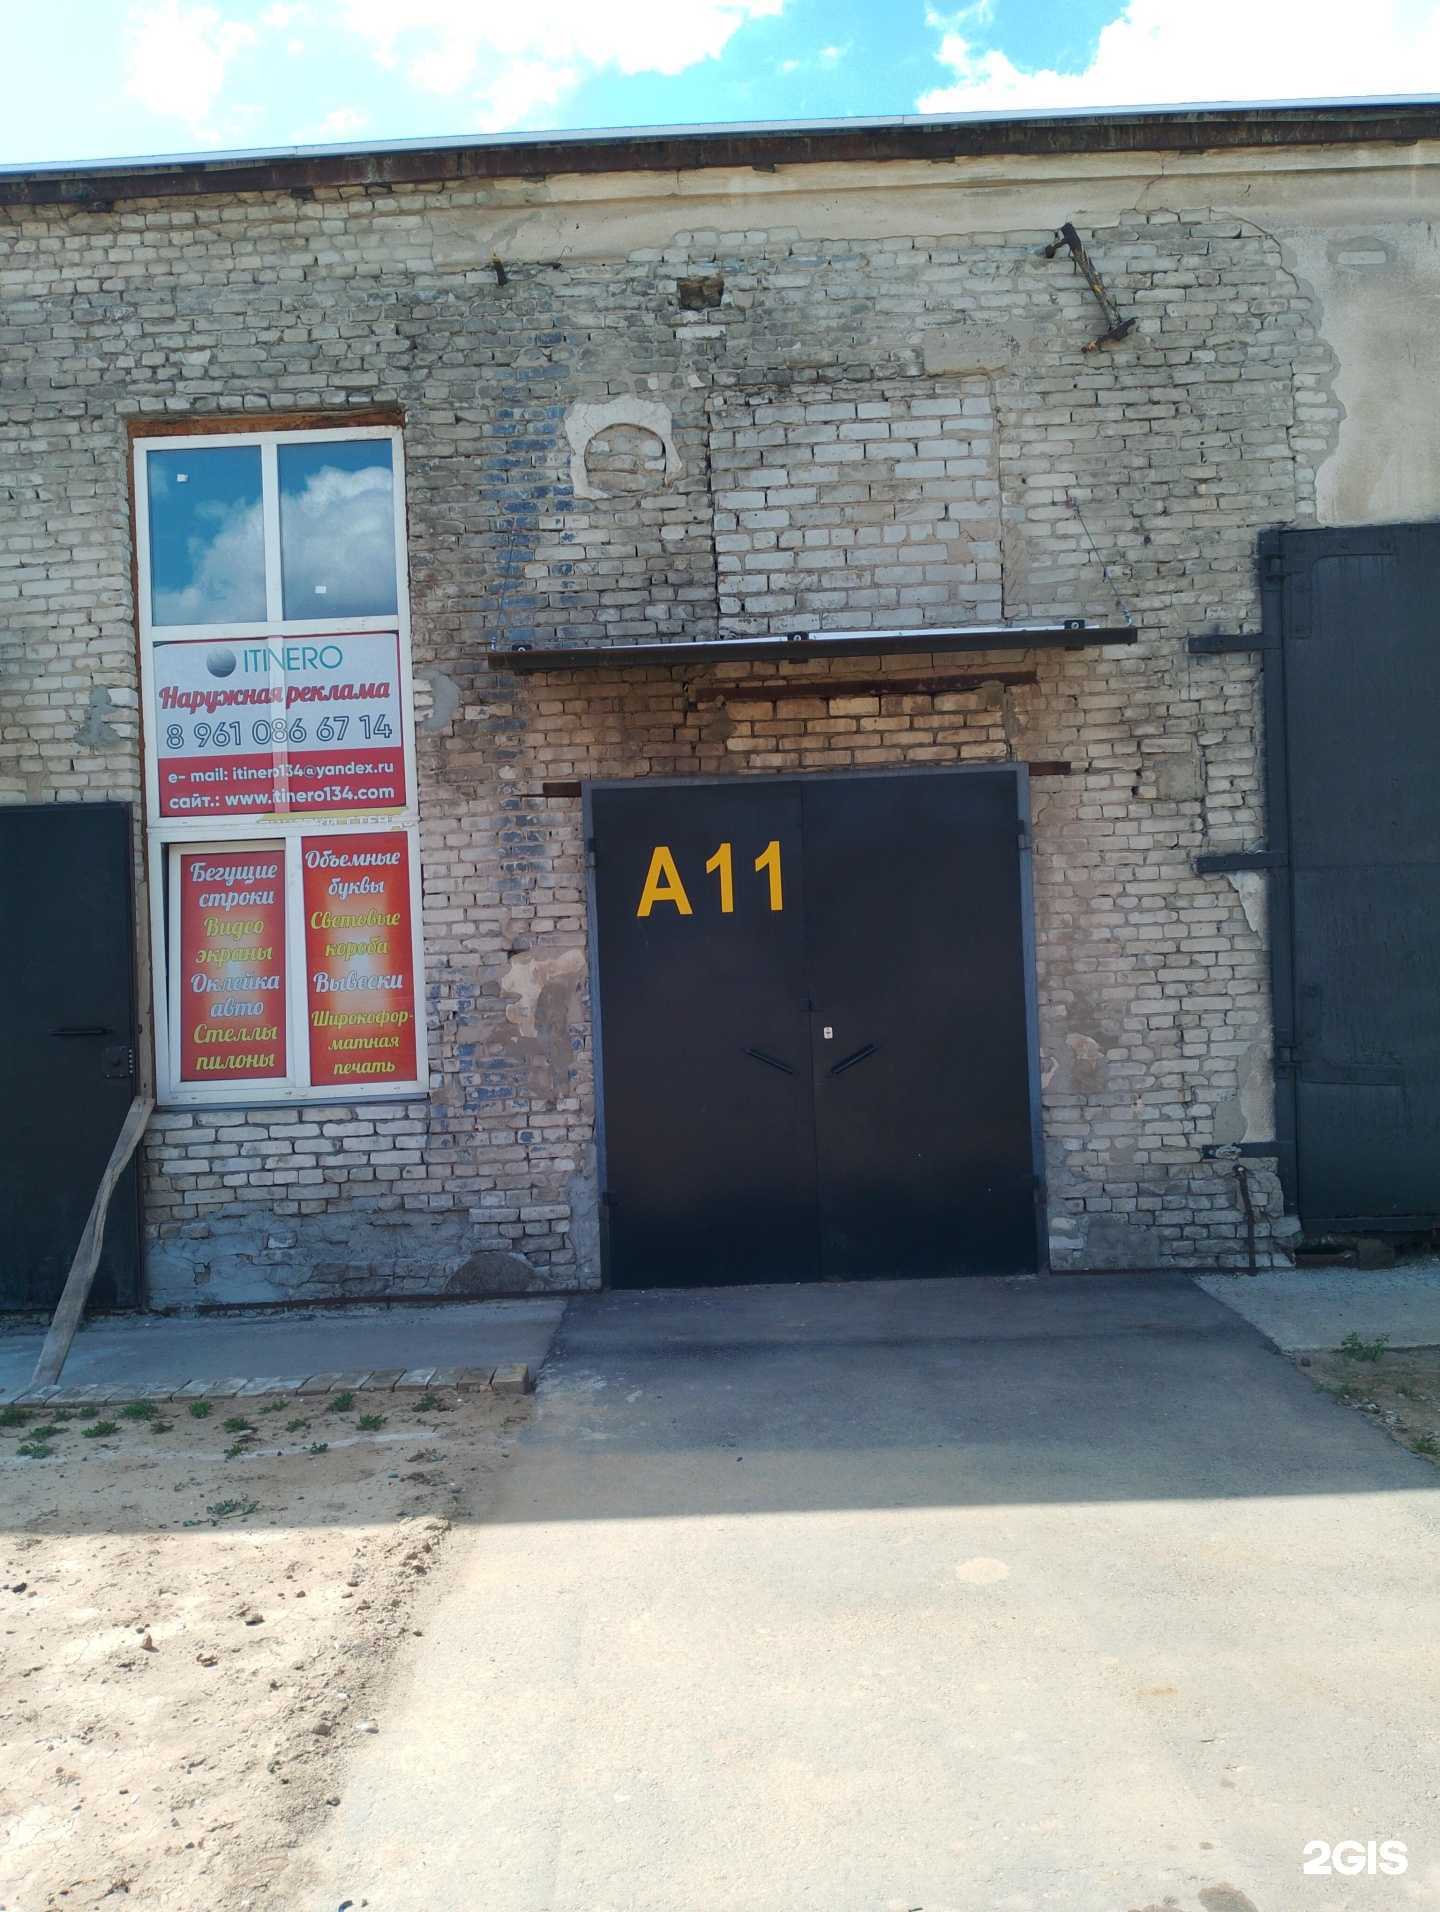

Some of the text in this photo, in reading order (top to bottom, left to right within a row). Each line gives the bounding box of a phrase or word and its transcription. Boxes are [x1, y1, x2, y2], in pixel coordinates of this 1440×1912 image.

[242, 645, 344, 673] ITINERO
[158, 681, 391, 714] Наружная реклама
[166, 714, 393, 750] 8 961 086 67 14
[190, 768, 229, 783] mail:
[232, 761, 395, 781] itinero134@yandex.ru
[169, 785, 395, 810] сайт.: www.itinero134.com
[305, 849, 401, 869] Объемные
[190, 861, 278, 885] Бегущие
[636, 840, 784, 917] A11
[328, 875, 385, 900] буквы
[199, 888, 274, 911] строки
[204, 916, 265, 941] Видео
[310, 908, 401, 930] Световые
[195, 945, 273, 969] экраны
[325, 935, 388, 961] короба
[190, 971, 280, 994] Оклейка
[313, 971, 404, 993] Вывески
[210, 995, 264, 1018] авто
[311, 1008, 413, 1030] Широкофор-
[193, 1023, 278, 1045] Стеллы
[327, 1035, 400, 1051] матная
[196, 1051, 275, 1072] пилоны
[333, 1060, 396, 1076] печать
